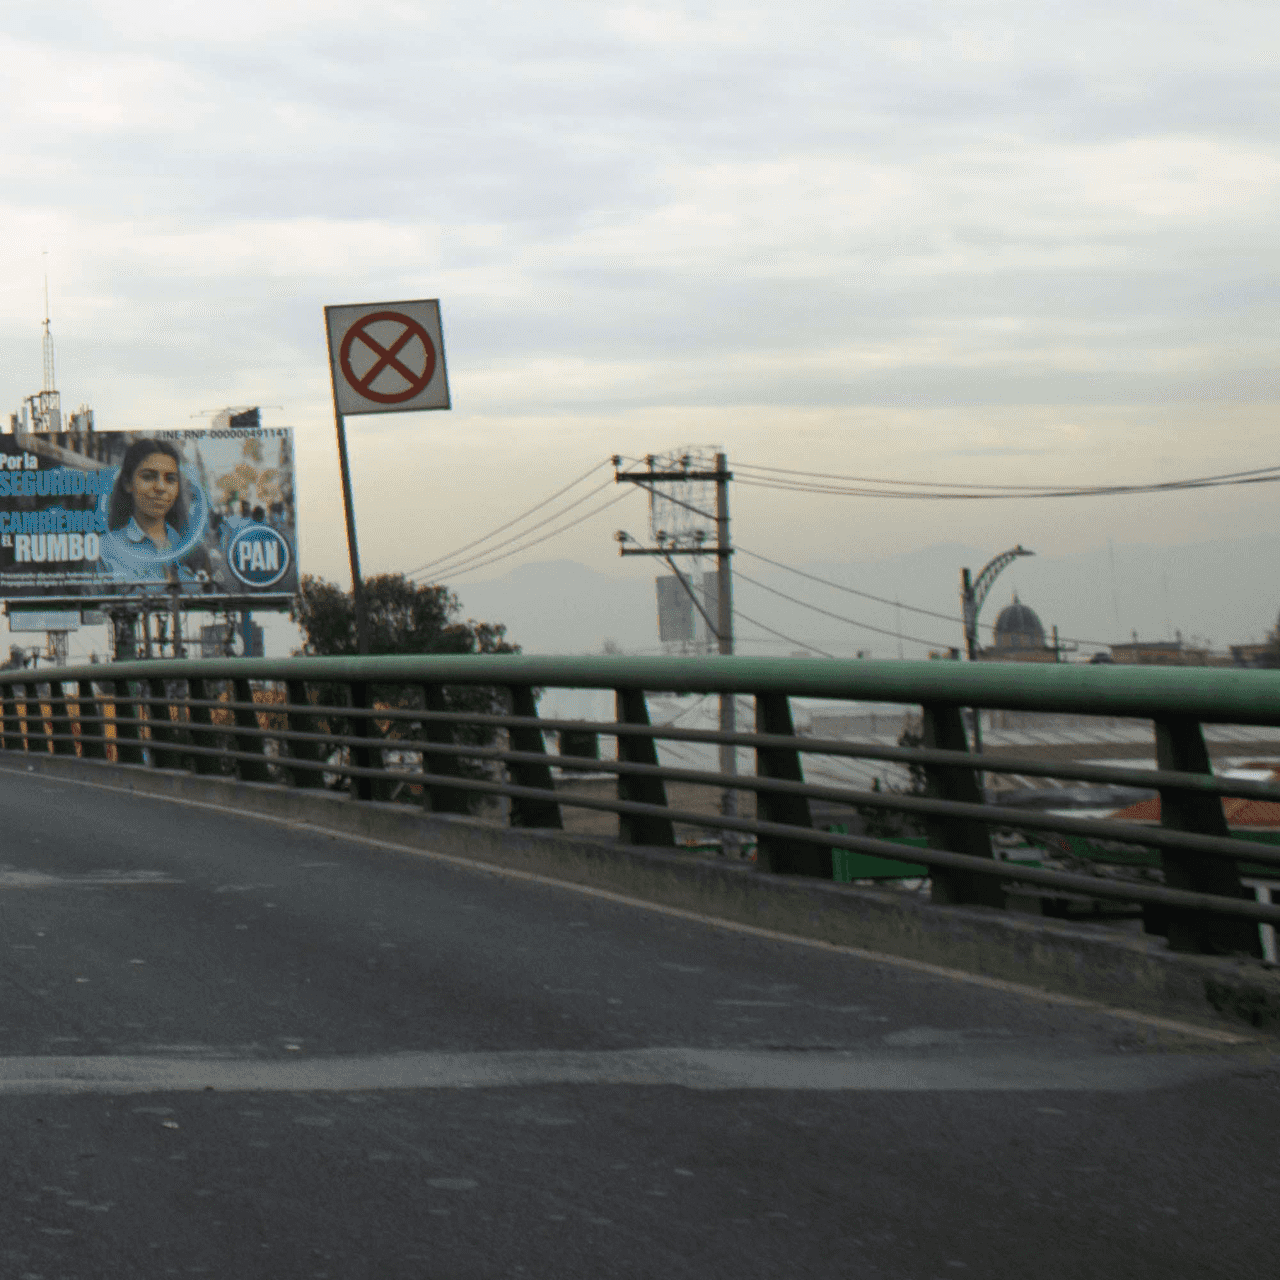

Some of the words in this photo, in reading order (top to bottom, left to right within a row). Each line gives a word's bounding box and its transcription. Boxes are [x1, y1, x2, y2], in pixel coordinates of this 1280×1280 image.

[24, 451, 39, 470] la
[15, 533, 100, 562] RUMBO
[238, 540, 280, 571] PAN
